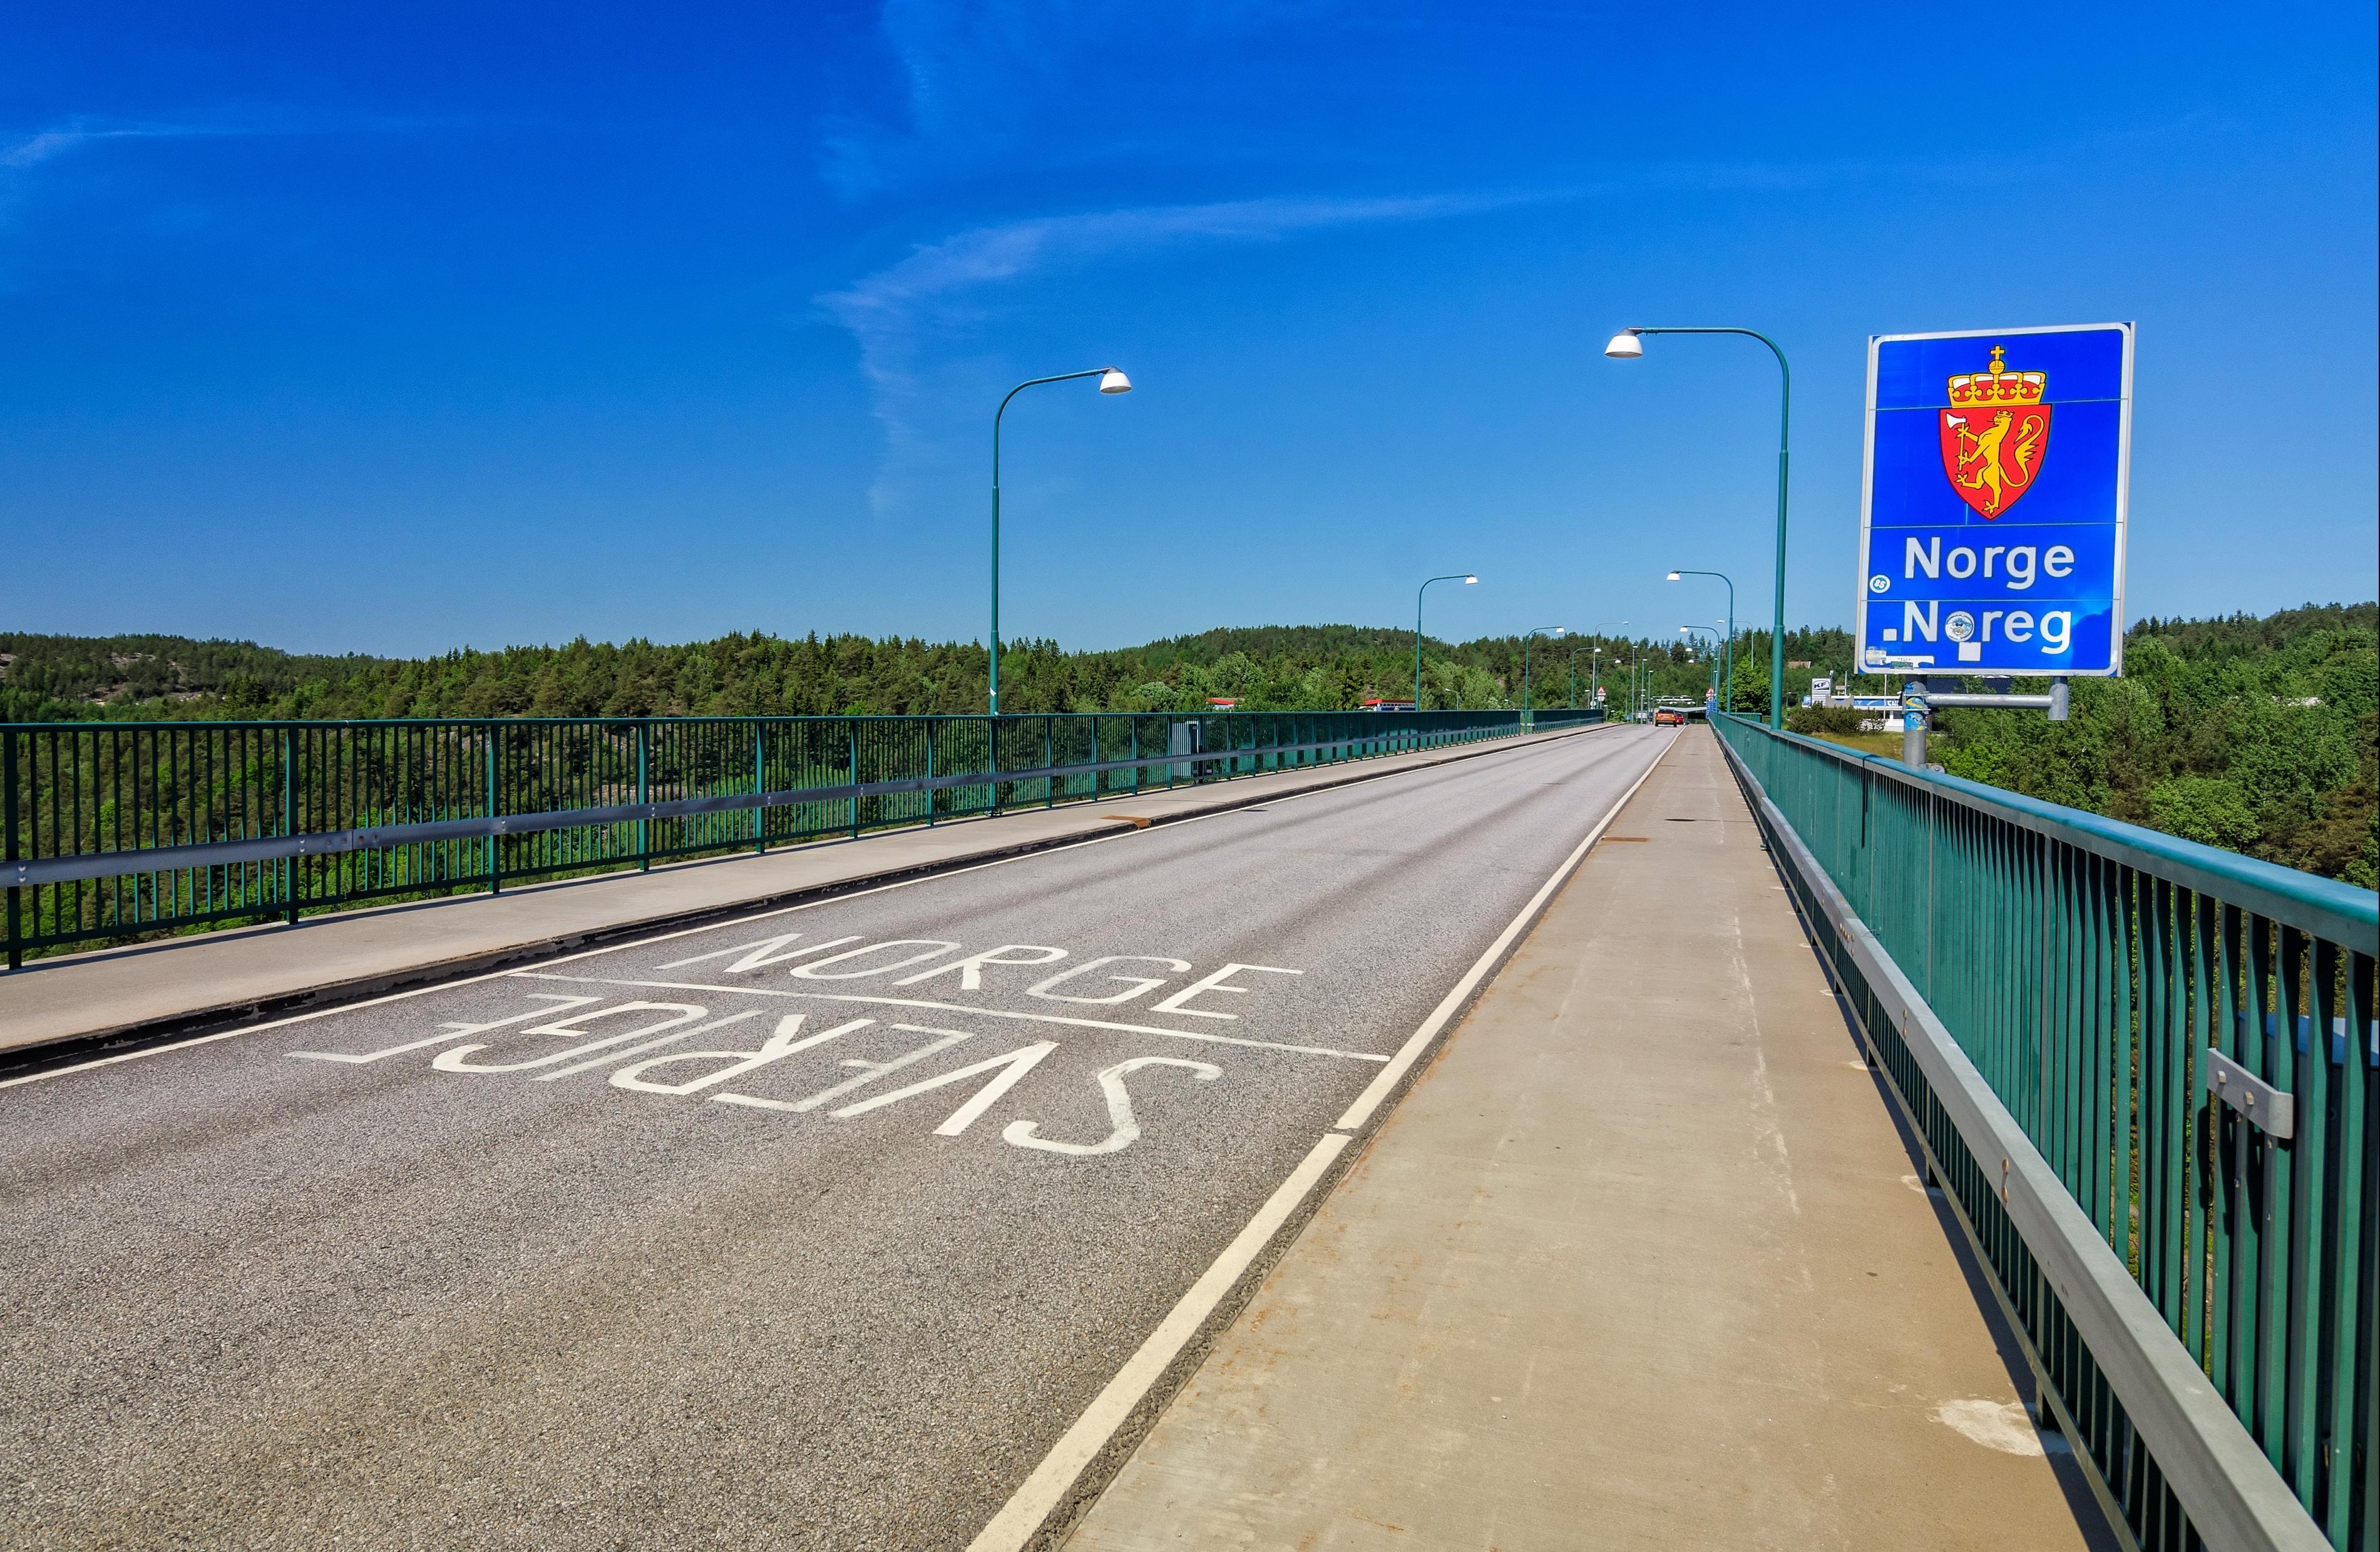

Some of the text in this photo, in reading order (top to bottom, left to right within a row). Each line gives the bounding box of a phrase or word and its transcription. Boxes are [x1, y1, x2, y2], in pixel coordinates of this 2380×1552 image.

[1904, 536, 2075, 590] Norge
[656, 933, 1304, 1019] NORGE
[285, 994, 1221, 1155] SVERIGE
